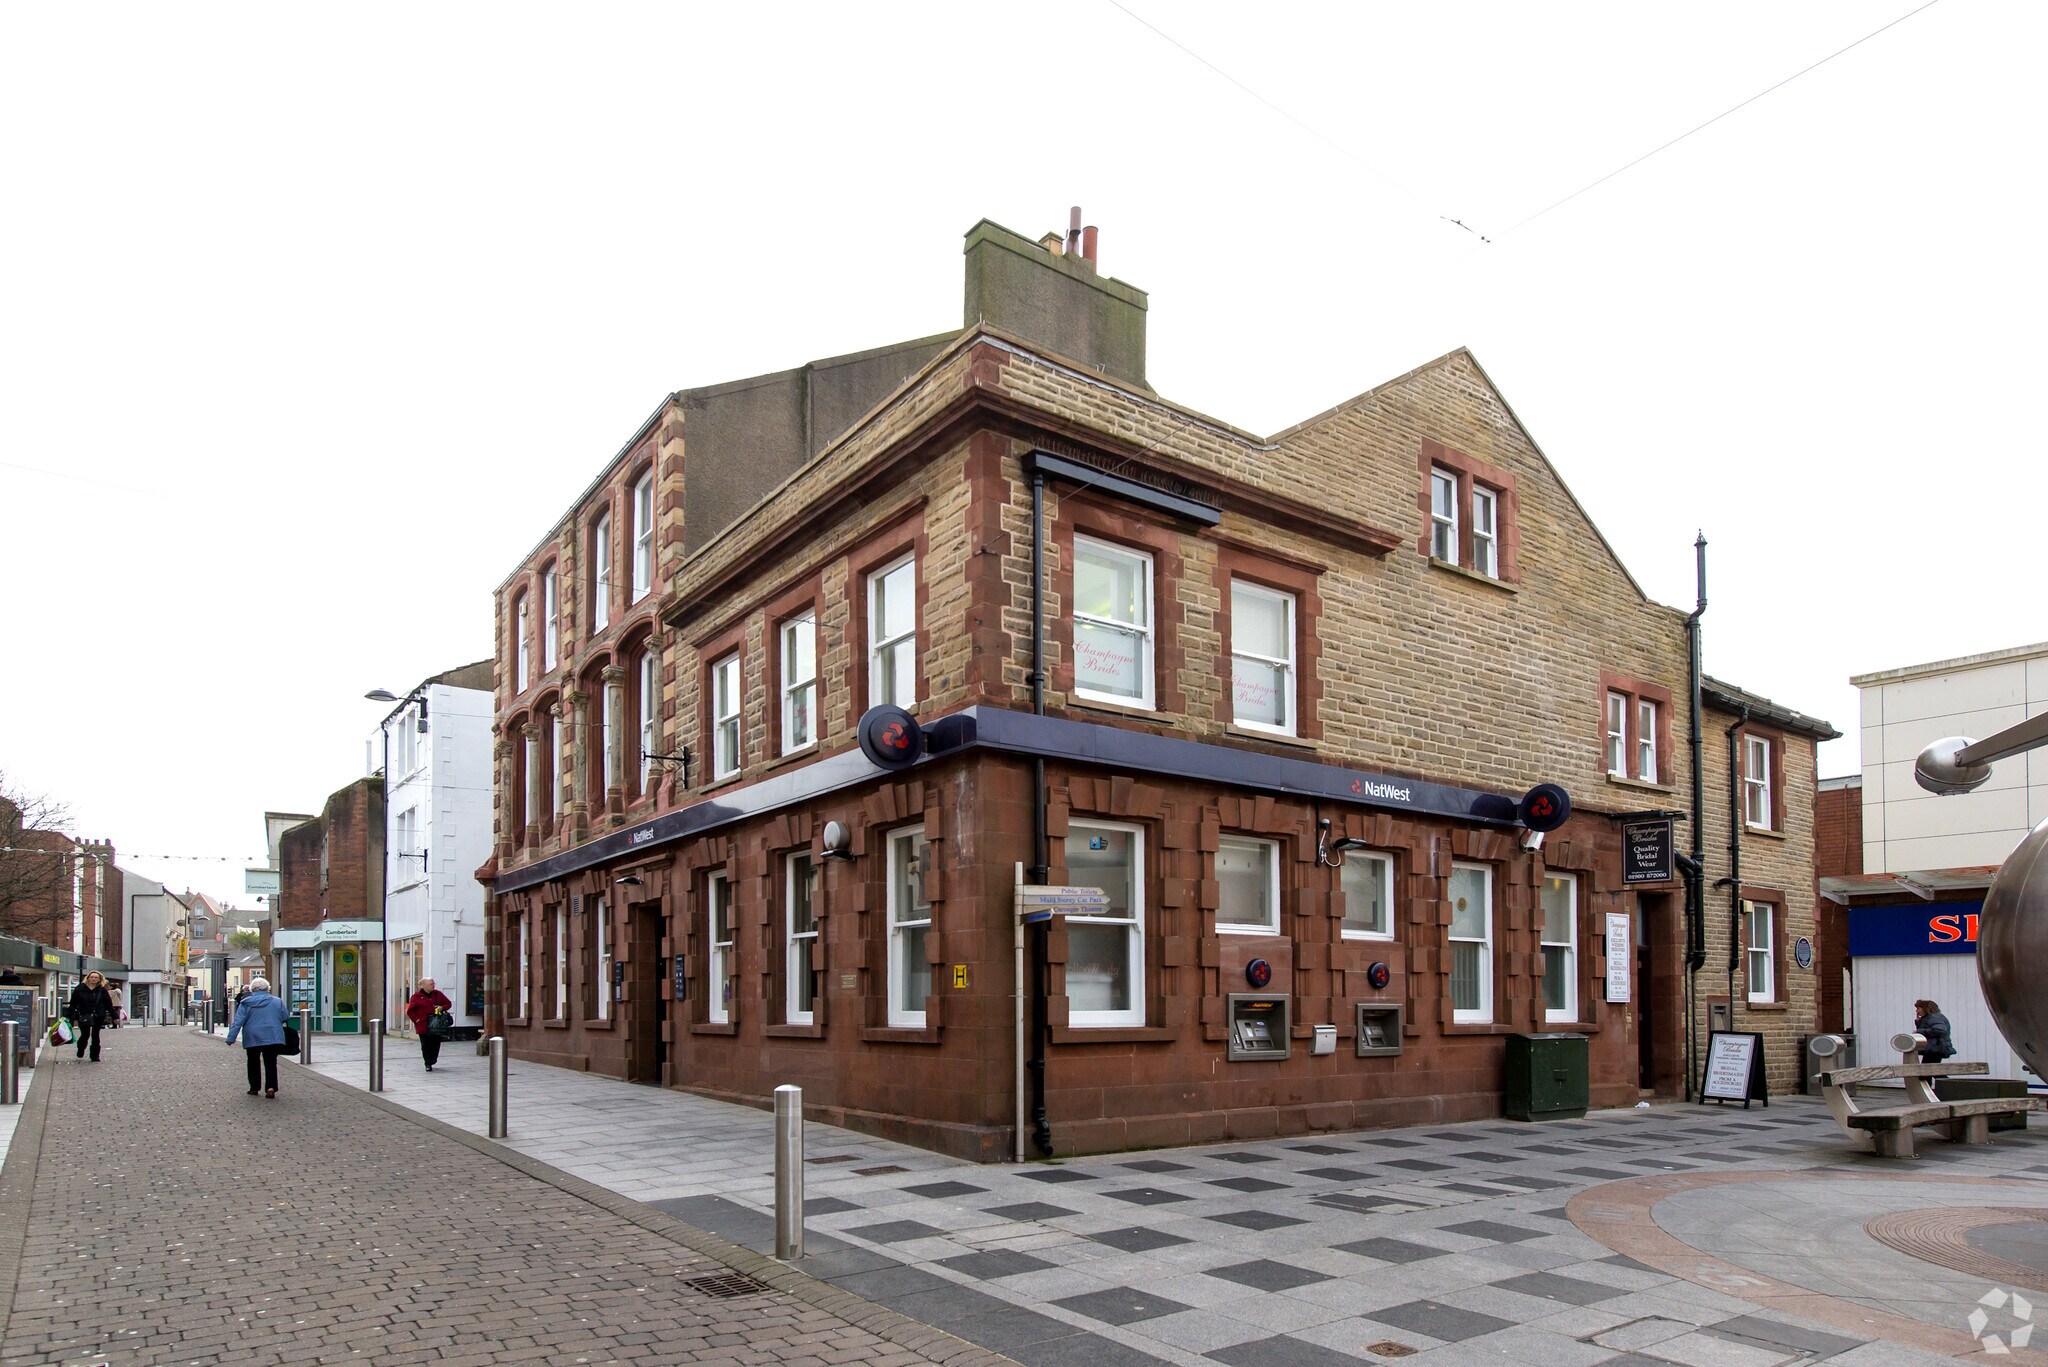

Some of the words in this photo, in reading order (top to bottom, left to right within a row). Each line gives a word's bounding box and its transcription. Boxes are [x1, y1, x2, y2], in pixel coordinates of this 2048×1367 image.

[1075, 641, 1136, 664] Champagne
[1083, 658, 1120, 676] Brides
[1236, 690, 1266, 706] Brides
[1365, 781, 1411, 801] NatWest
[633, 827, 654, 844] NatWest
[1626, 826, 1667, 836] Champagne
[1631, 834, 1658, 843] Brides
[1633, 844, 1660, 853] Quality
[1636, 852, 1658, 860] Bridal
[1718, 1038, 1748, 1049] Champagne
